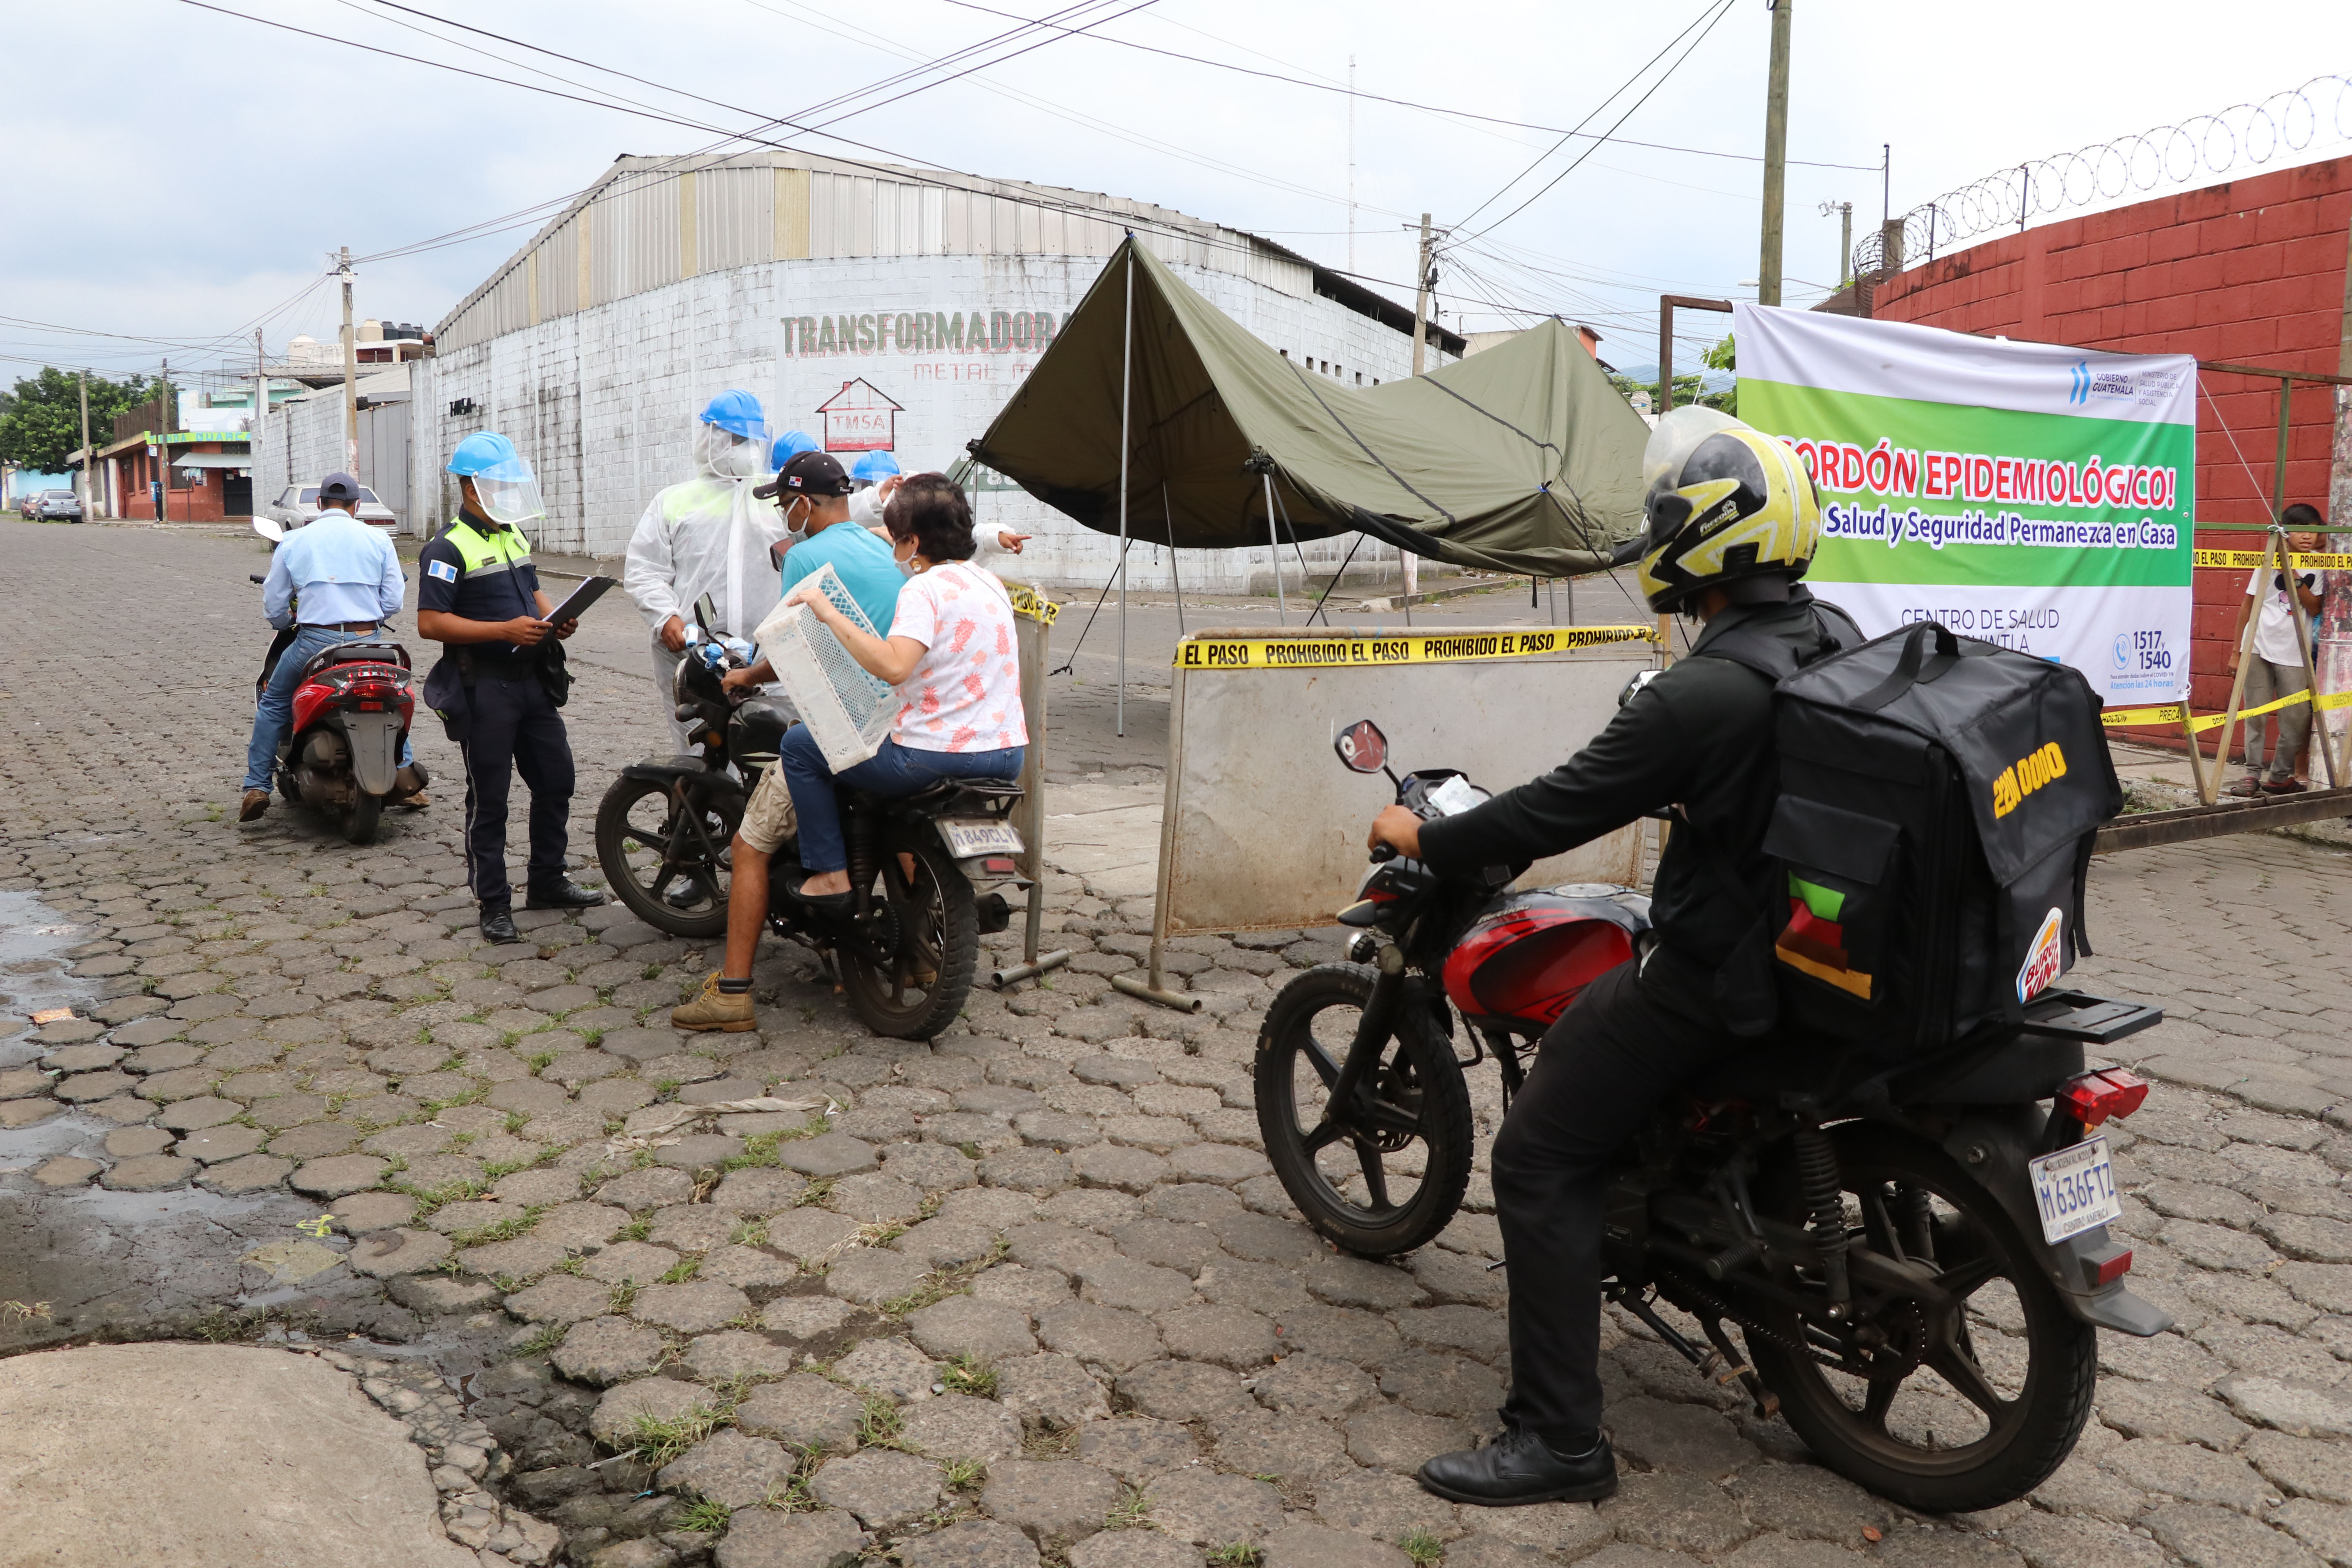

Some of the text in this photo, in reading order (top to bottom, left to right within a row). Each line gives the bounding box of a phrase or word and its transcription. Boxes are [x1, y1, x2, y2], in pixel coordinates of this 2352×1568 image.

[780, 311, 1070, 358] TRANSFORMADOR
[914, 363, 997, 380] METAL
[2096, 373, 2128, 383] GOBIERNO
[2142, 371, 2169, 379] MINISTERIO
[2092, 383, 2134, 396] GUATEMALA
[2139, 379, 2180, 389] SALUD PÚBLICA
[2143, 390, 2174, 398] ASISTENCIA
[833, 414, 886, 430] TMSA
[1782, 440, 2174, 507] ORDÓN EPIDEMIOLÓGICO!
[1826, 506, 2174, 545] Salud y Seguridad Permanezca en Casa
[2201, 552, 2208, 565] EL
[2210, 552, 2227, 565] PASO
[2300, 555, 2336, 567] PROHIBIDO
[2337, 556, 2345, 568] EL
[1902, 609, 2060, 630] CENTRO DE SALUD
[1425, 633, 1554, 659] PROHIBIDO EL PASO
[2133, 631, 2165, 650] 1517 y
[1185, 644, 1249, 664] EL PASO
[1265, 641, 1408, 664] PROHIBIDO EL PASO
[2139, 650, 2171, 670] 1540
[2110, 680, 2134, 690] Atención
[2145, 679, 2152, 688] 24
[2153, 679, 2174, 687] horas
[2025, 923, 2059, 988] BURGER
[2026, 941, 2059, 1002] KING
[2040, 1162, 2114, 1221] M 636FTZ
